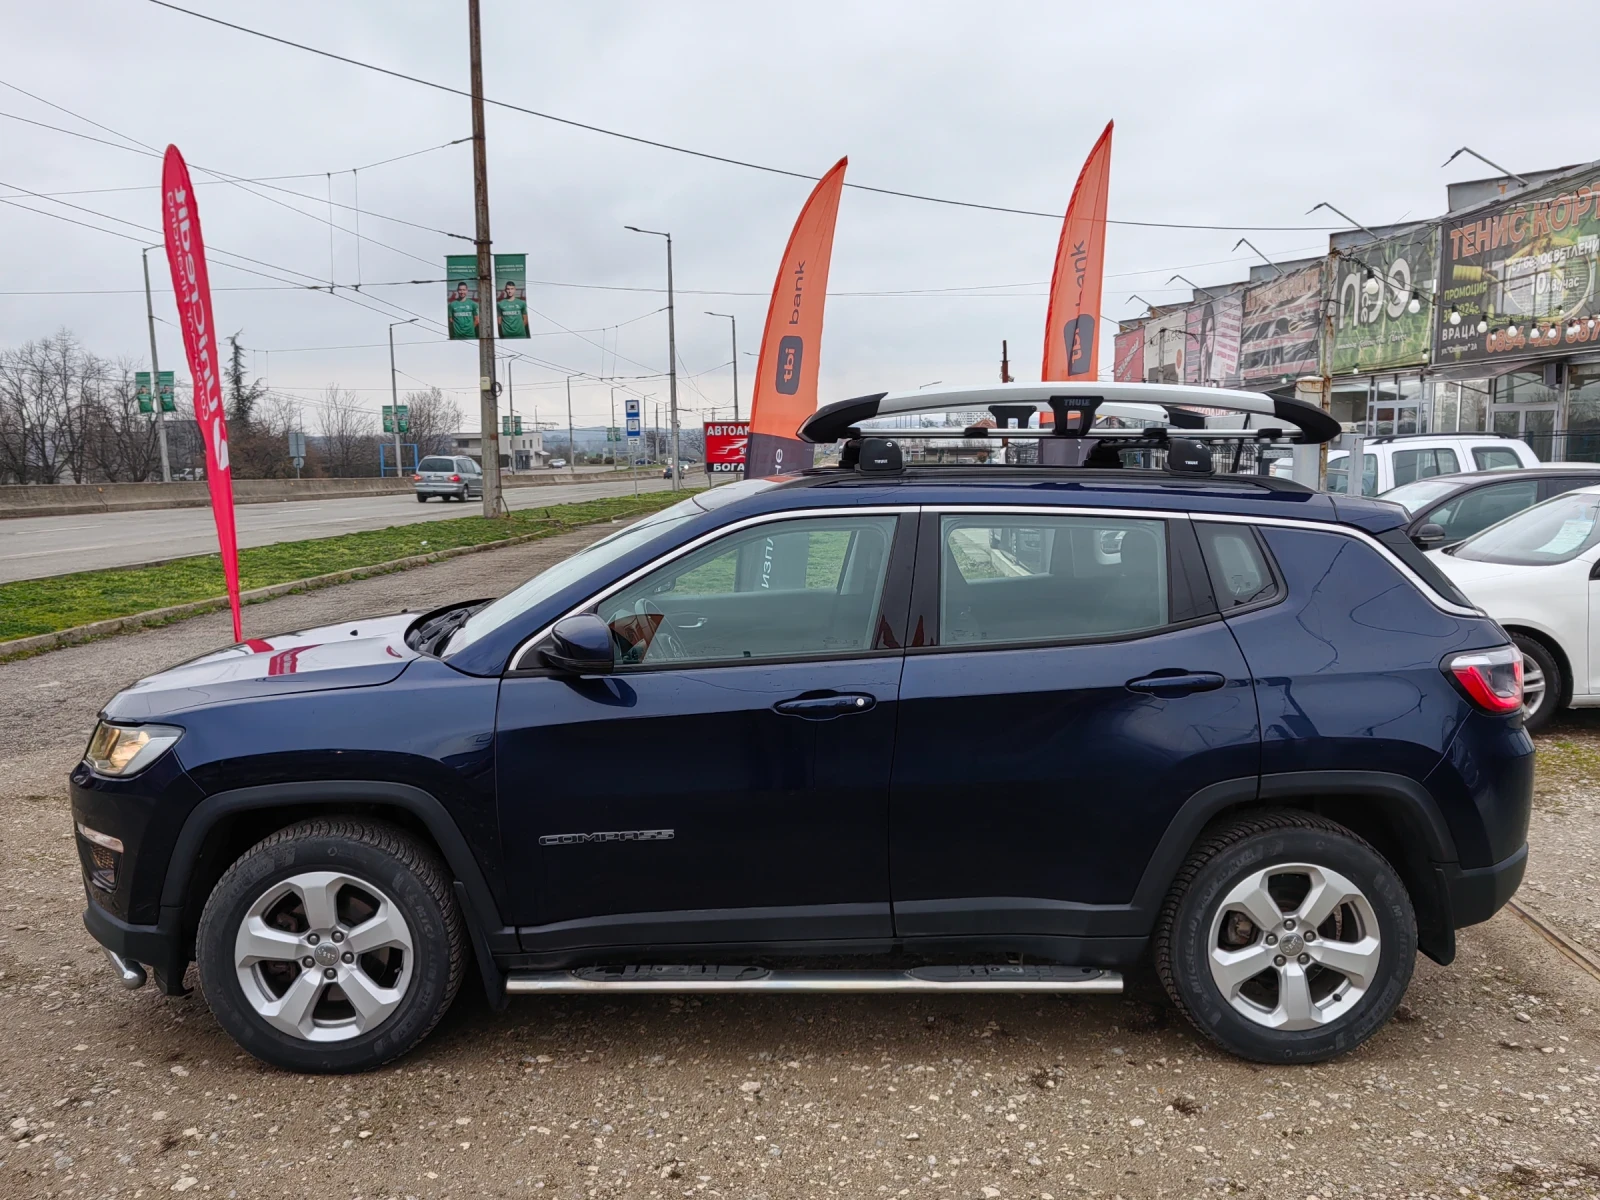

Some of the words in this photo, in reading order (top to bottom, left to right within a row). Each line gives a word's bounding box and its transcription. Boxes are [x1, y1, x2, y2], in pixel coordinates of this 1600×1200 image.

[1450, 207, 1527, 260] ТЕНИС
[789, 260, 806, 325] bank
[1444, 281, 1488, 302] ПРОМОЦИЯ
[1442, 324, 1479, 341] ВРАЦА,
[783, 347, 796, 383] tbi
[1064, 398, 1091, 407] THULE
[538, 829, 675, 846] COMPASS
